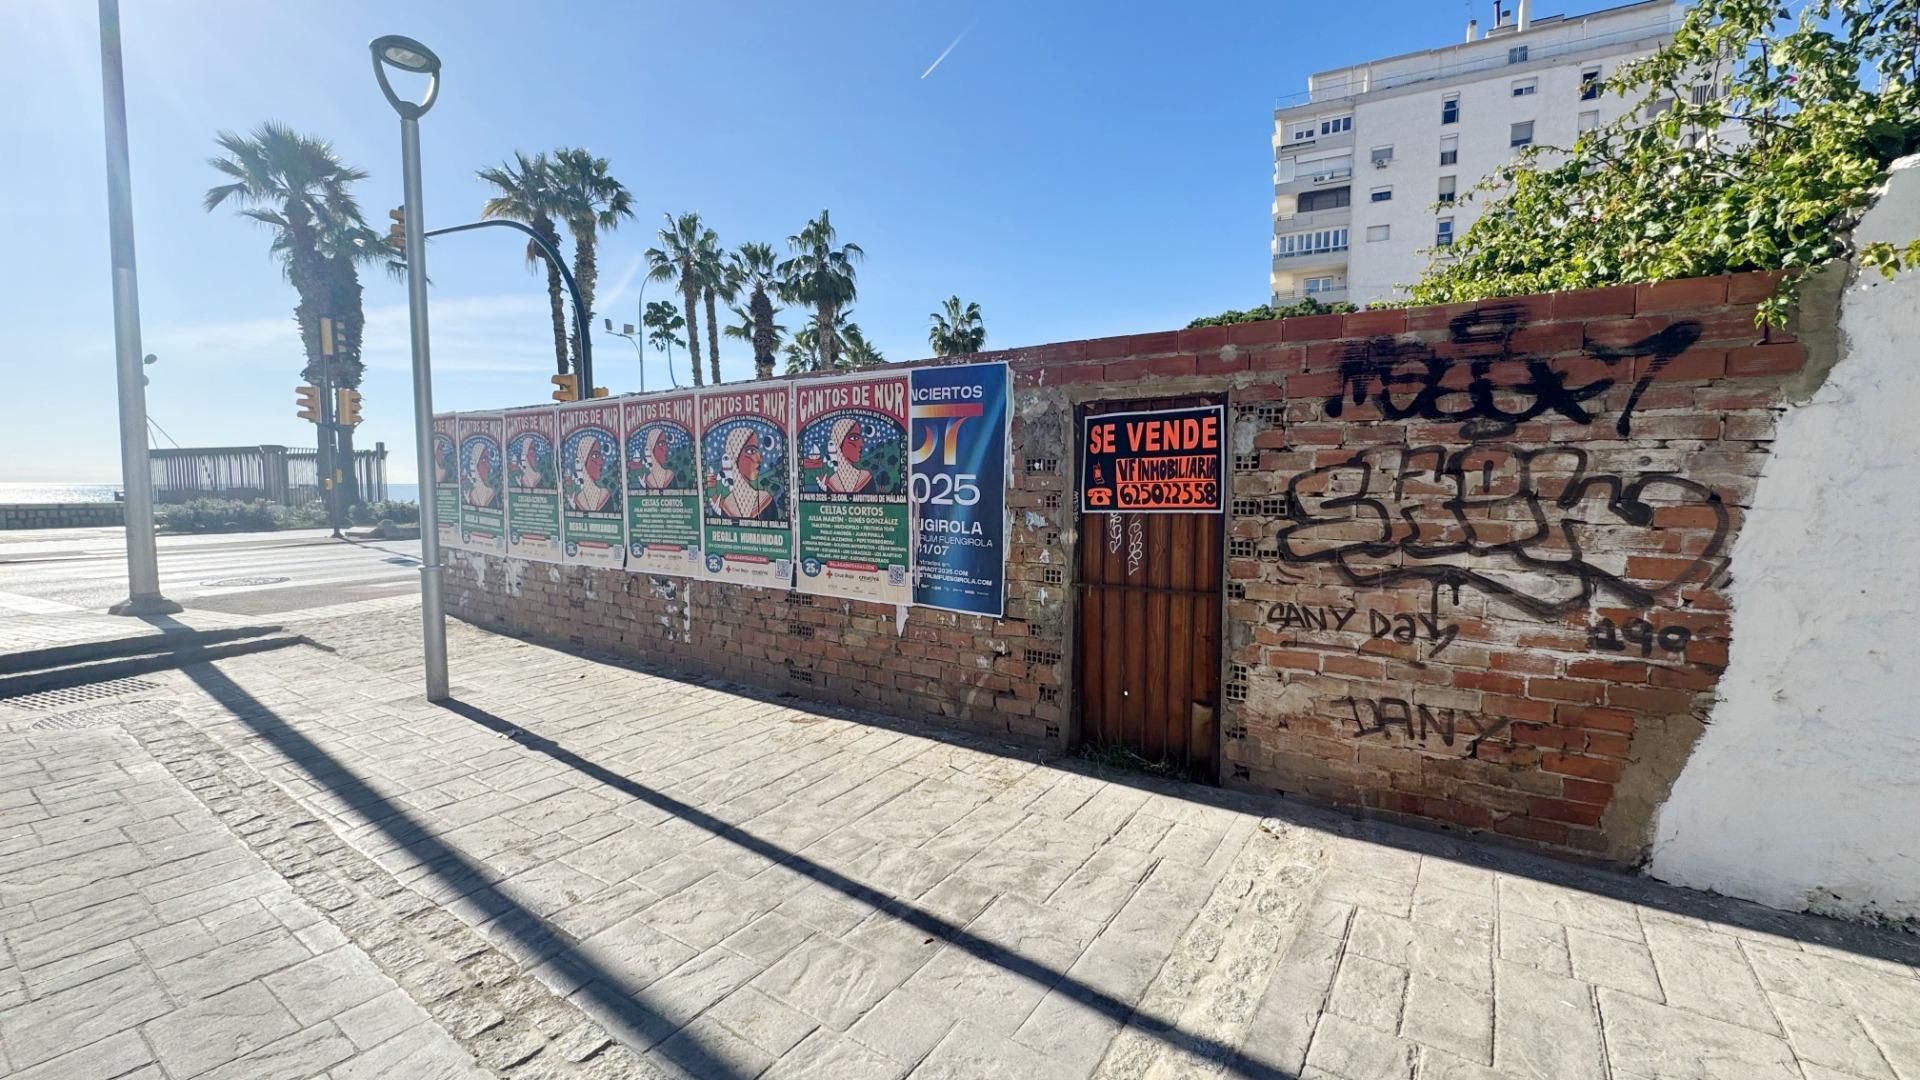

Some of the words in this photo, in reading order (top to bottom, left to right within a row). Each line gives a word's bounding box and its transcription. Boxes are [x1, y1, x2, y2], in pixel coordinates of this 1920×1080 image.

[625, 404, 657, 432] CANTOS
[659, 401, 672, 419] DE
[673, 399, 692, 427] NUR
[702, 396, 742, 427] CANTOS
[745, 394, 760, 413] DE
[762, 391, 786, 424] NUR
[800, 388, 849, 422] CANTOS
[852, 385, 870, 406] DE
[874, 382, 905, 418] NUR
[561, 411, 589, 436] CANTOS
[590, 409, 601, 425] DE
[602, 407, 619, 433] NUR
[1089, 423, 1116, 455] SE
[1126, 417, 1217, 452] VENDE
[1119, 482, 1217, 506] 625022558
[819, 505, 847, 515] CELTAS
[848, 506, 884, 516] CORTOS
[712, 530, 738, 543] REGALA
[740, 532, 784, 546] HUMANIDAD
[939, 536, 993, 548] FUENGIROLA
